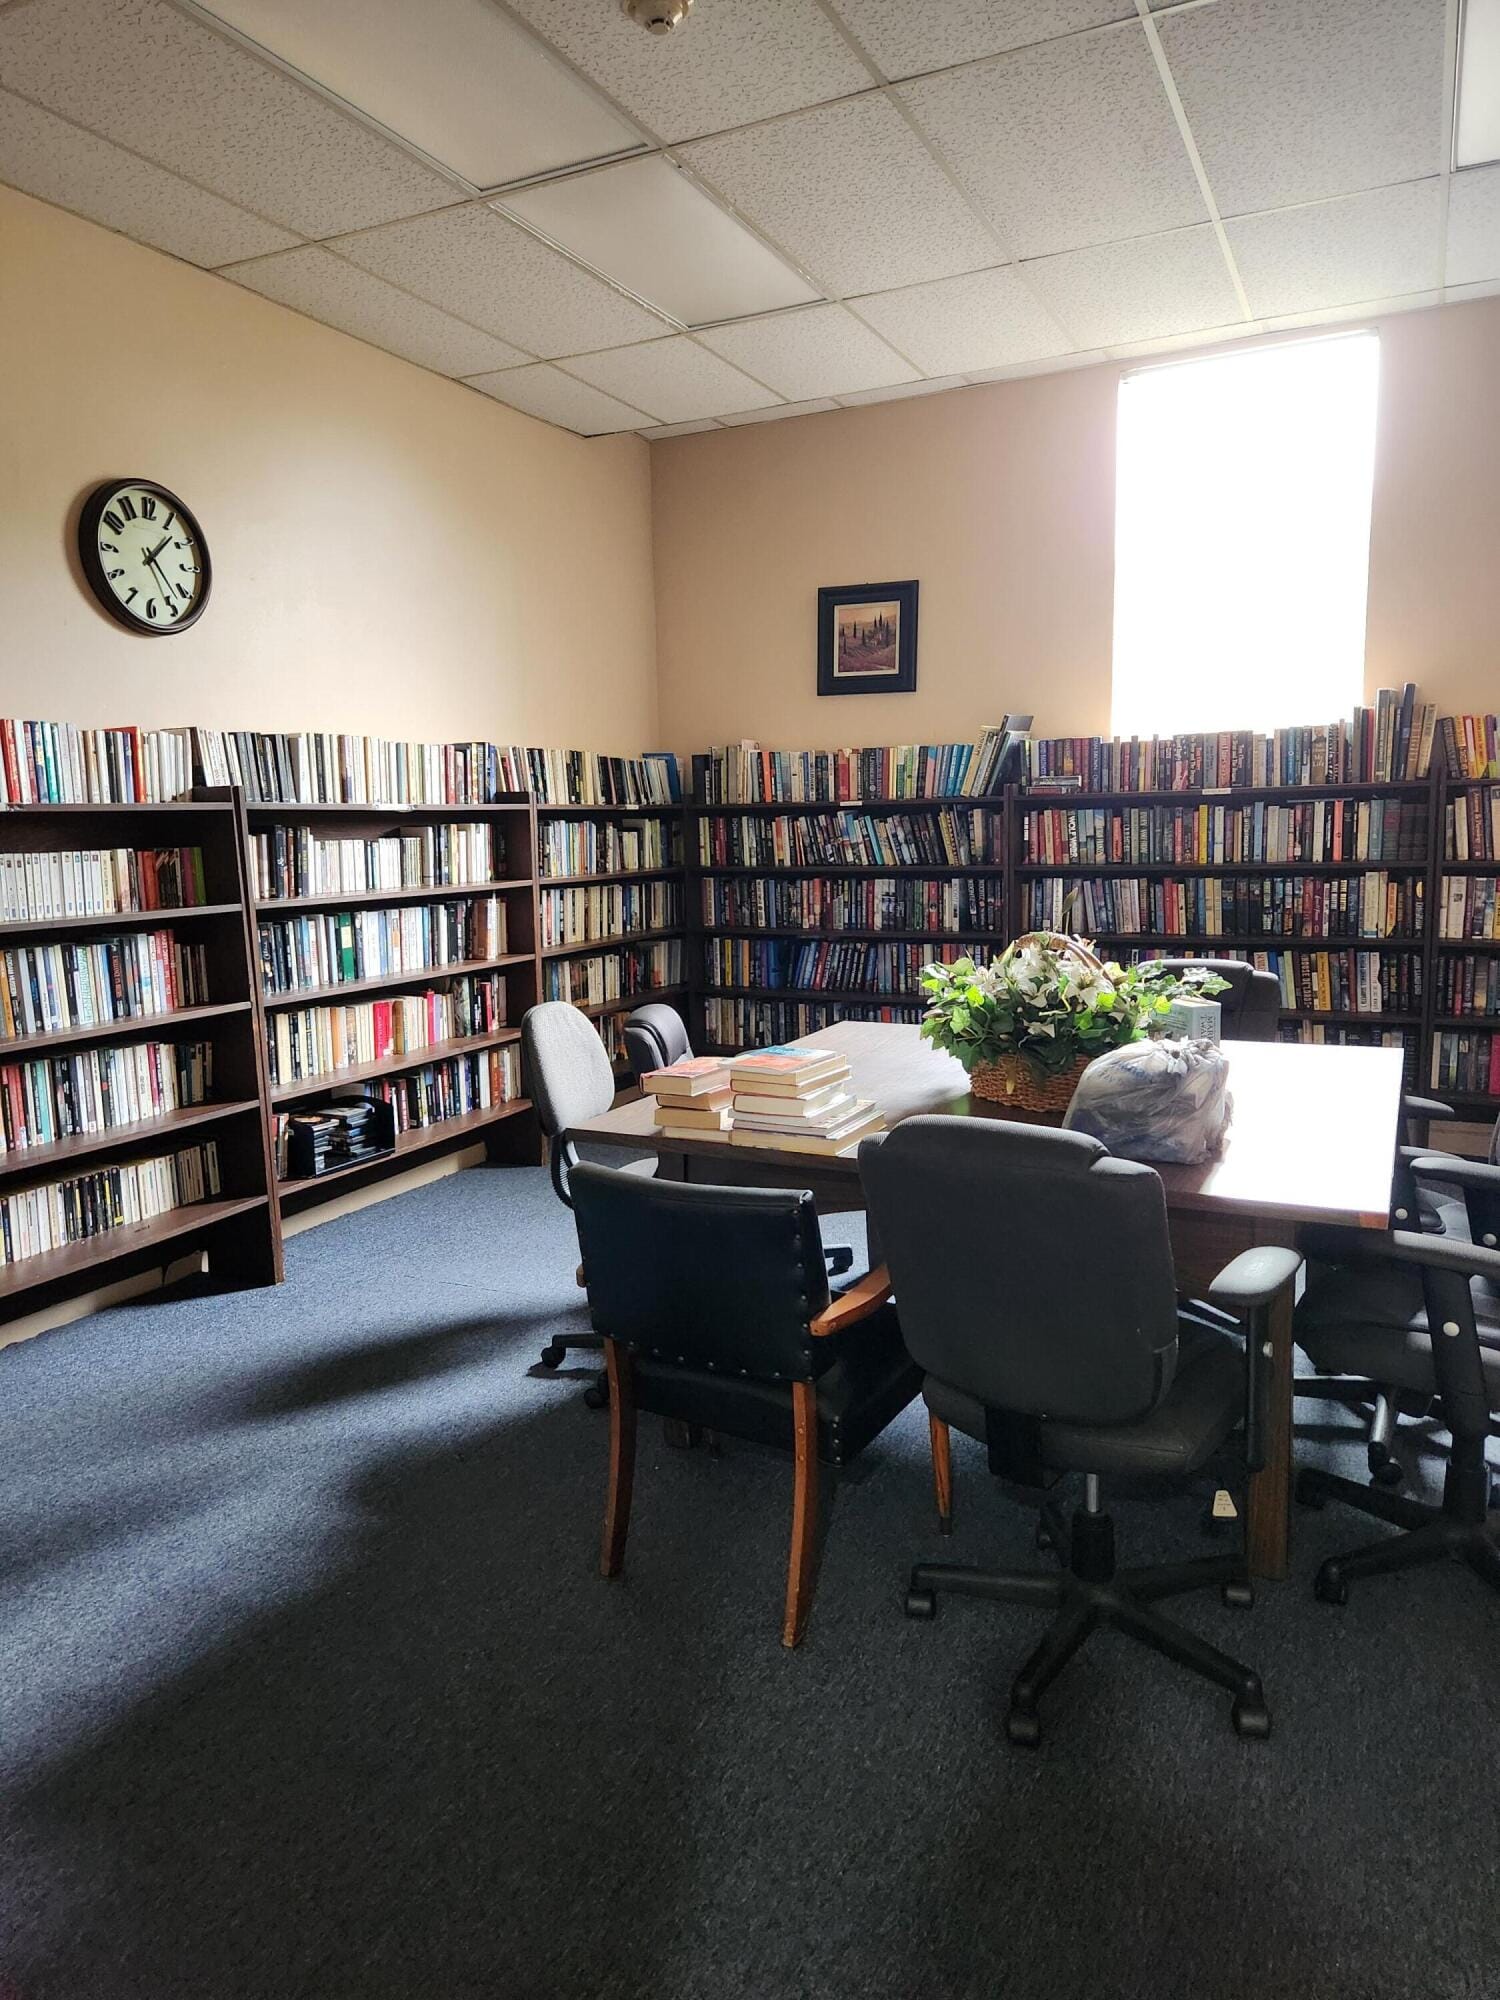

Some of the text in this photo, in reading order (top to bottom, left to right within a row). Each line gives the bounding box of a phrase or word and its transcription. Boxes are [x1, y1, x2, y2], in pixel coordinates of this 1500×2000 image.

[116, 496, 138, 521] 11
[141, 496, 157, 521] 12
[102, 510, 125, 536] 10
[162, 512, 176, 530] 1
[100, 541, 120, 554] 9
[174, 536, 194, 550] 2
[107, 568, 125, 581] 8
[179, 563, 201, 574] 3
[124, 587, 139, 605] 7
[175, 583, 194, 600] 4
[145, 598, 157, 619] 6
[164, 595, 179, 618] 5
[1068, 815, 1076, 836] WOLF
